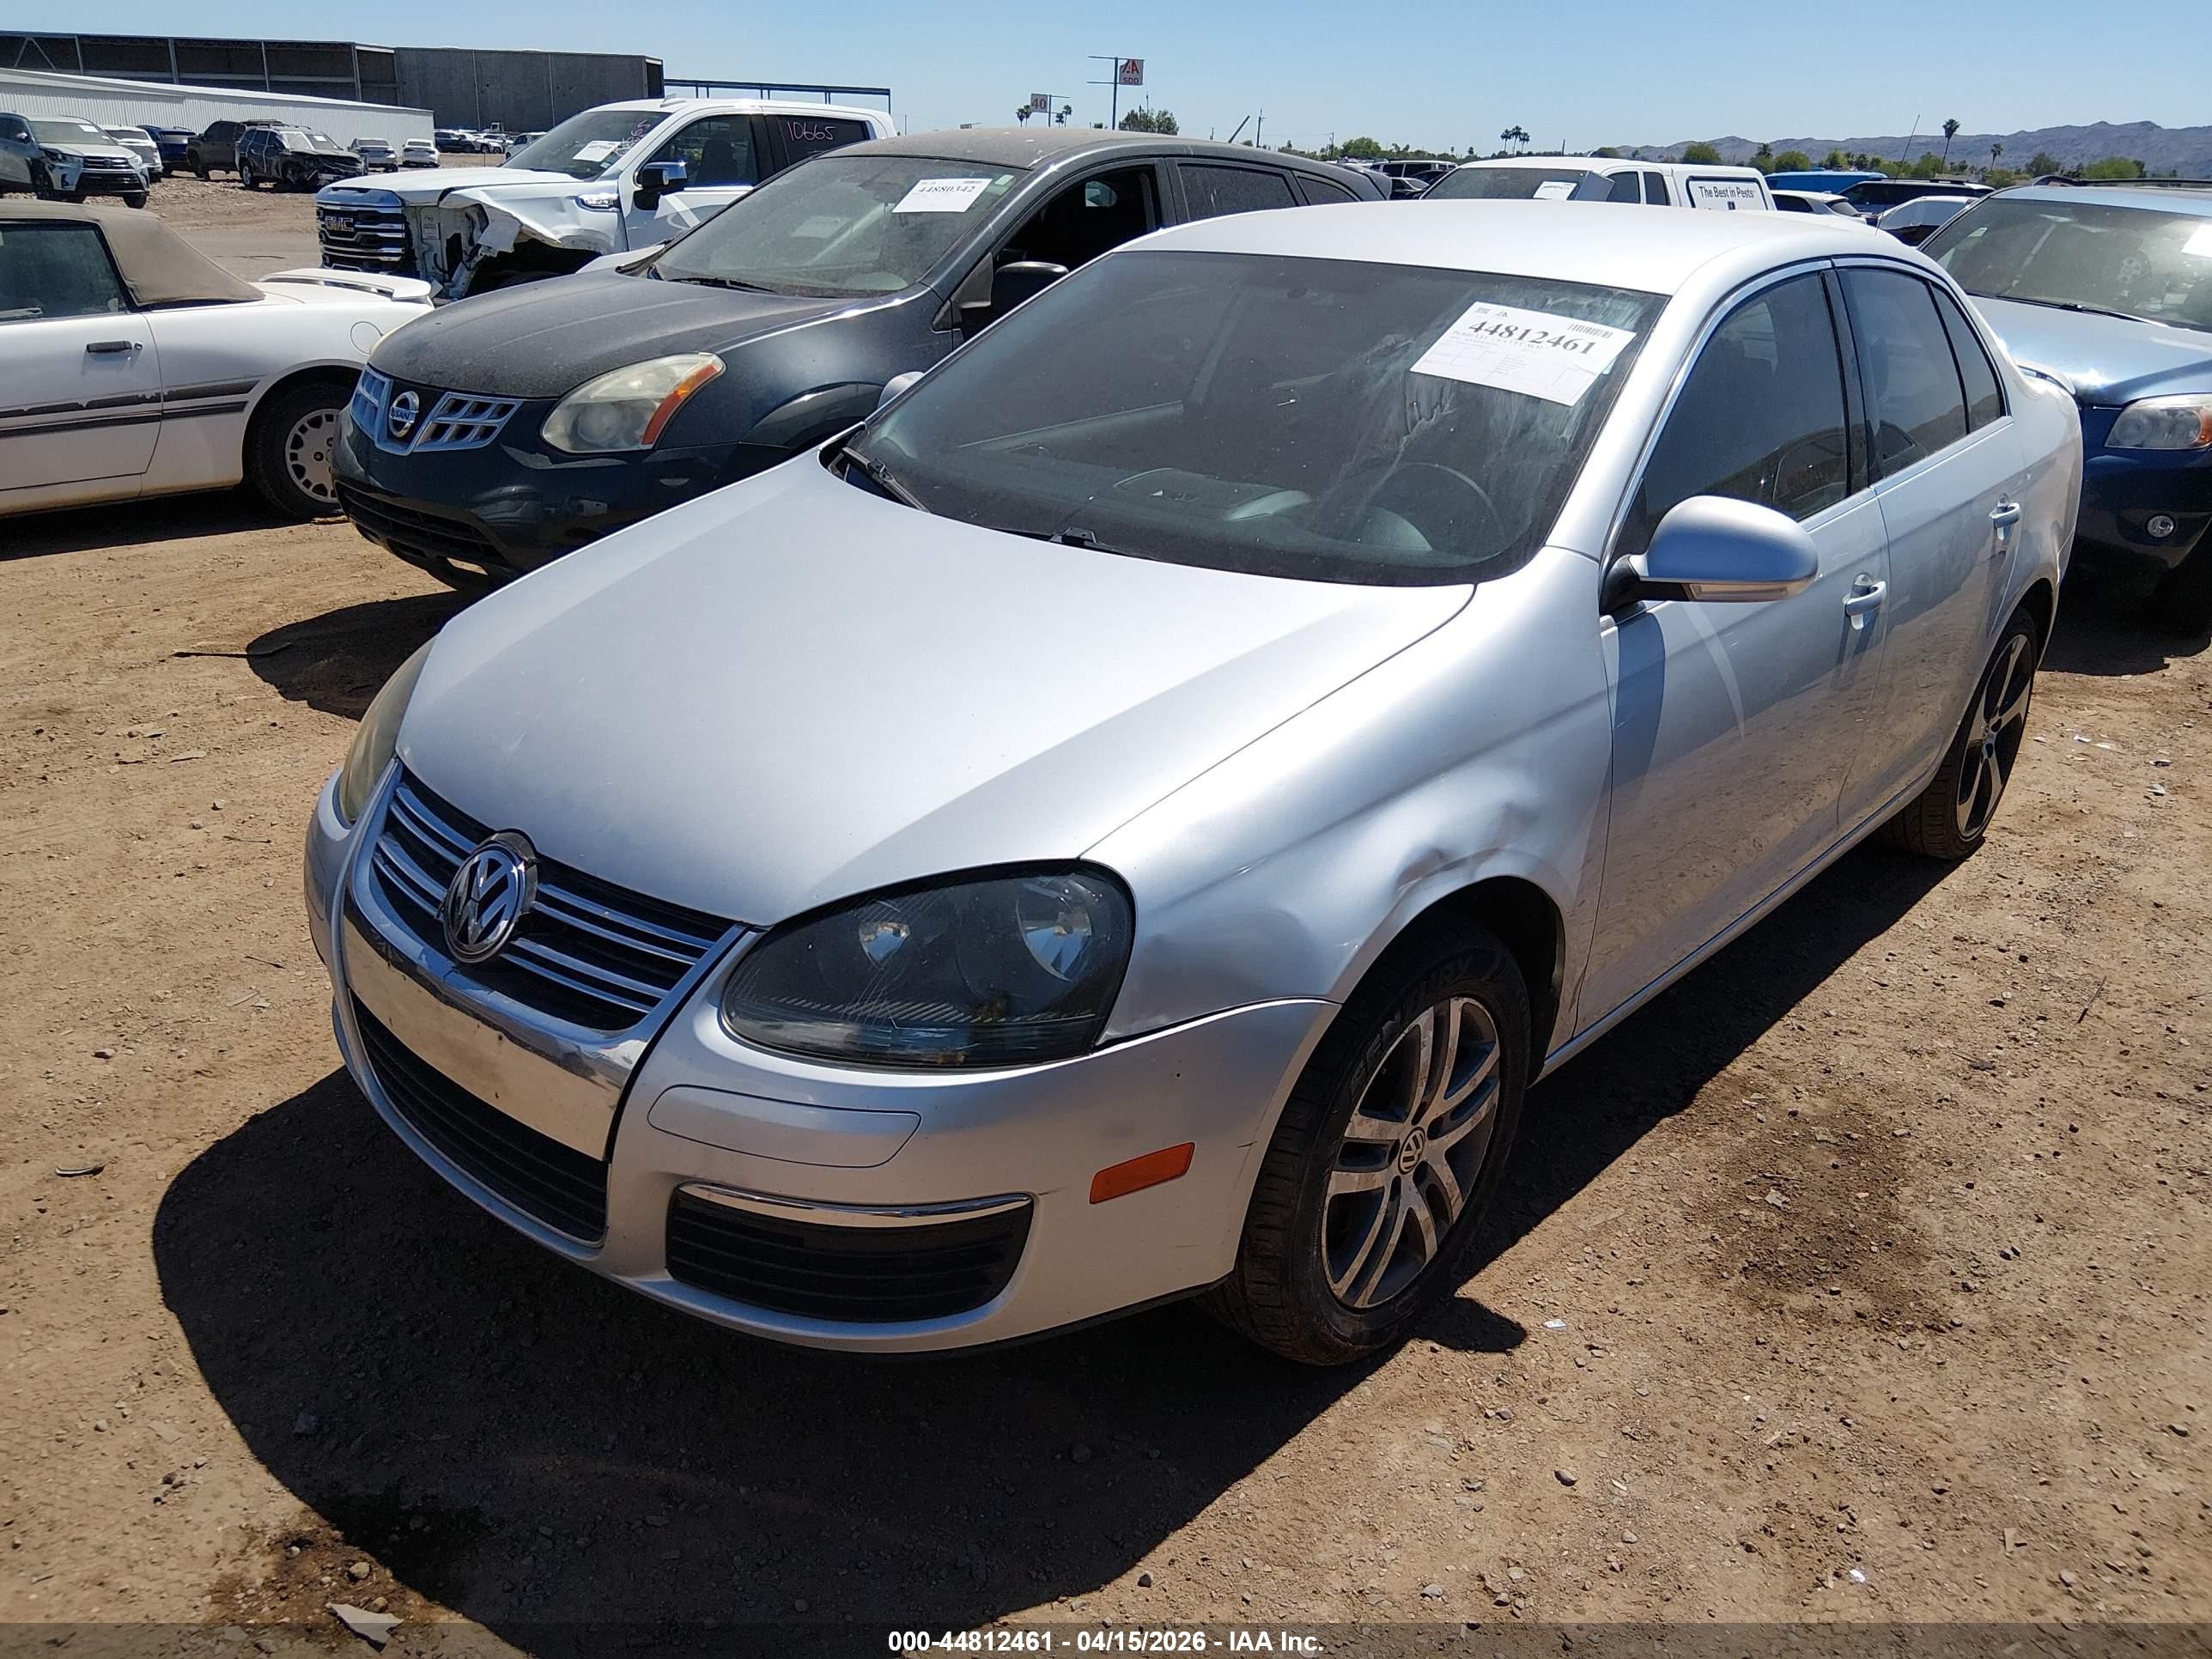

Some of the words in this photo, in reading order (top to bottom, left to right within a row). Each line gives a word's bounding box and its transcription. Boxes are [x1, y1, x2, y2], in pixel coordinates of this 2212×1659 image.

[1031, 97, 1047, 110] 40
[787, 121, 837, 142] 10665
[1698, 185, 1713, 198] The
[1713, 186, 1729, 198] Best
[1729, 186, 1736, 198] in
[1736, 187, 1754, 198] Pests
[325, 216, 355, 232] GMC
[1468, 320, 1597, 355] 44812461
